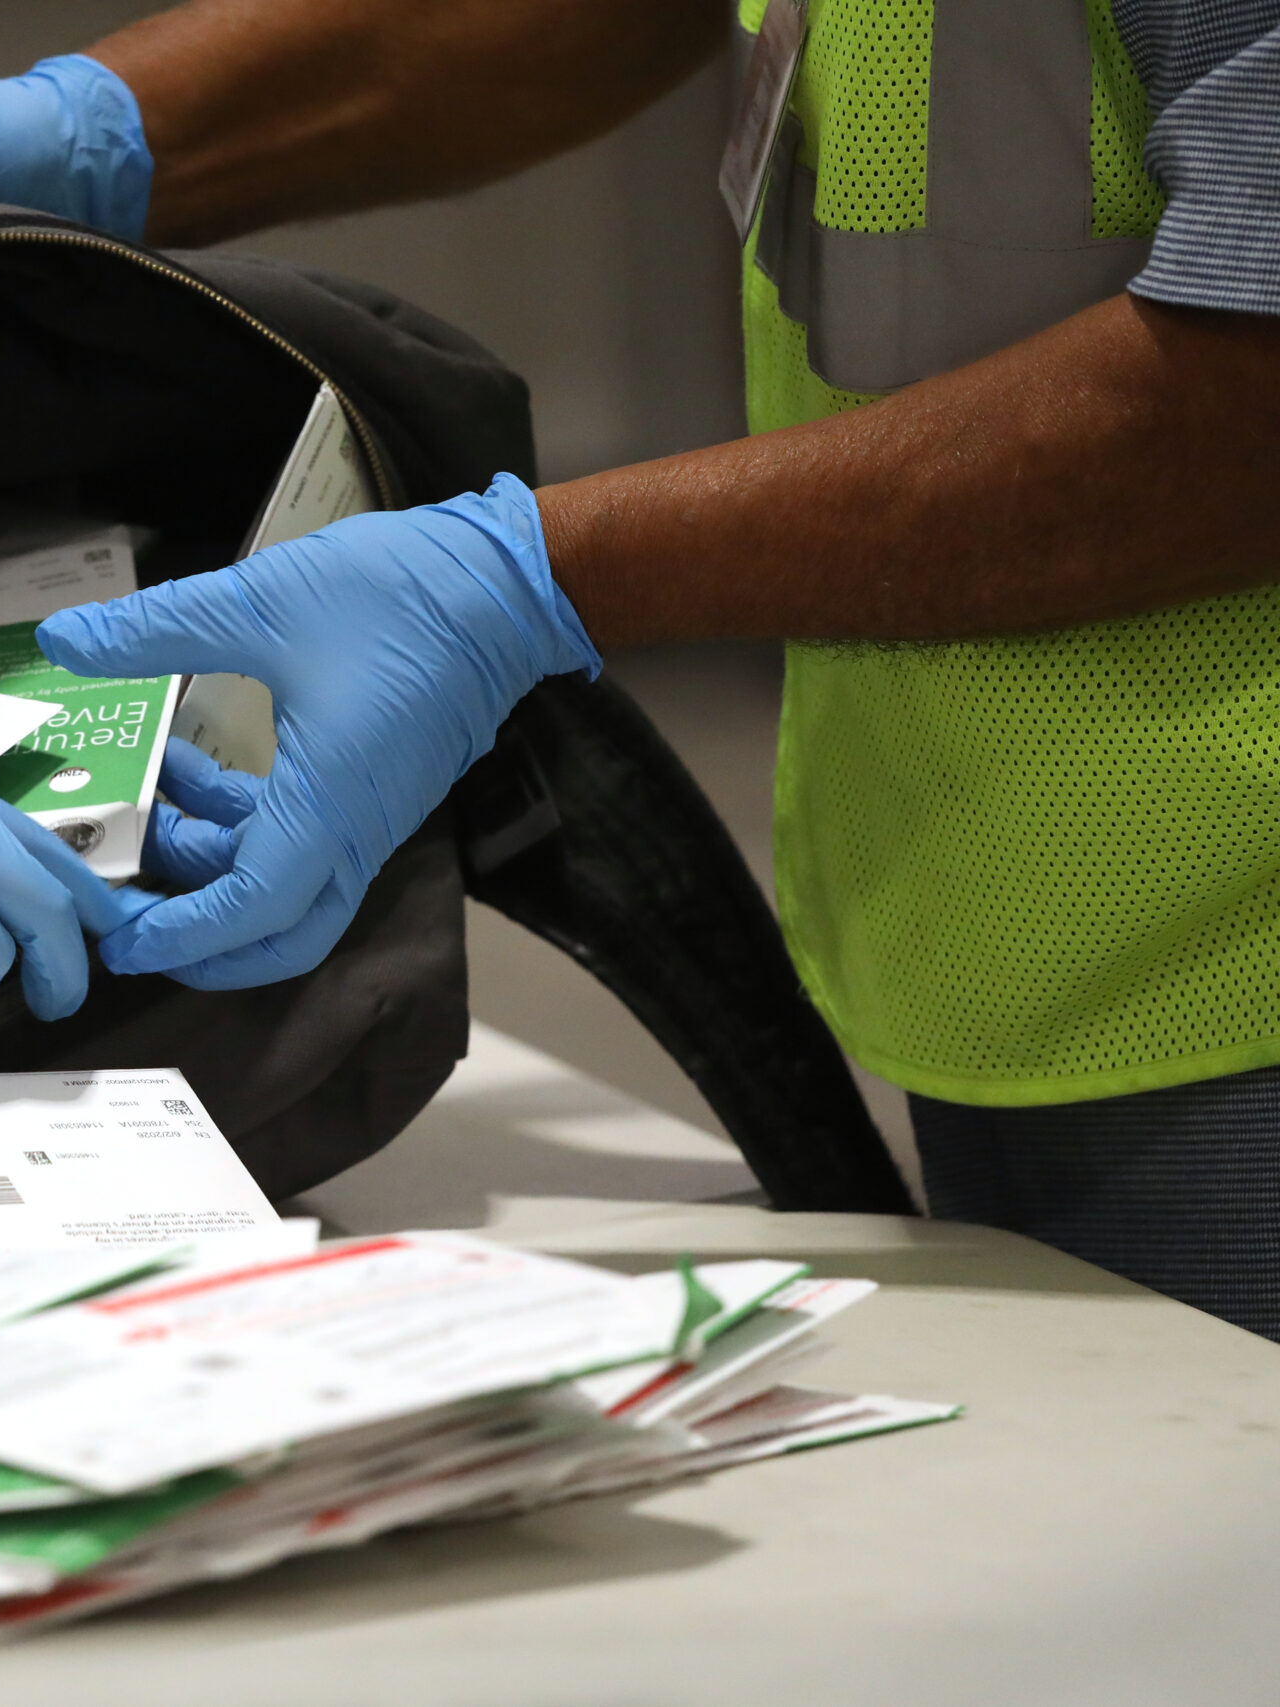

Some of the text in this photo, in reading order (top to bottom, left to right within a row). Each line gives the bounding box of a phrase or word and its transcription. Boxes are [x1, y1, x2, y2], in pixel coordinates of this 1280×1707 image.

[81, 679, 125, 690] opened
[55, 685, 78, 693] only
[112, 1221, 151, 1229] driver's
[187, 1218, 235, 1226] signature
